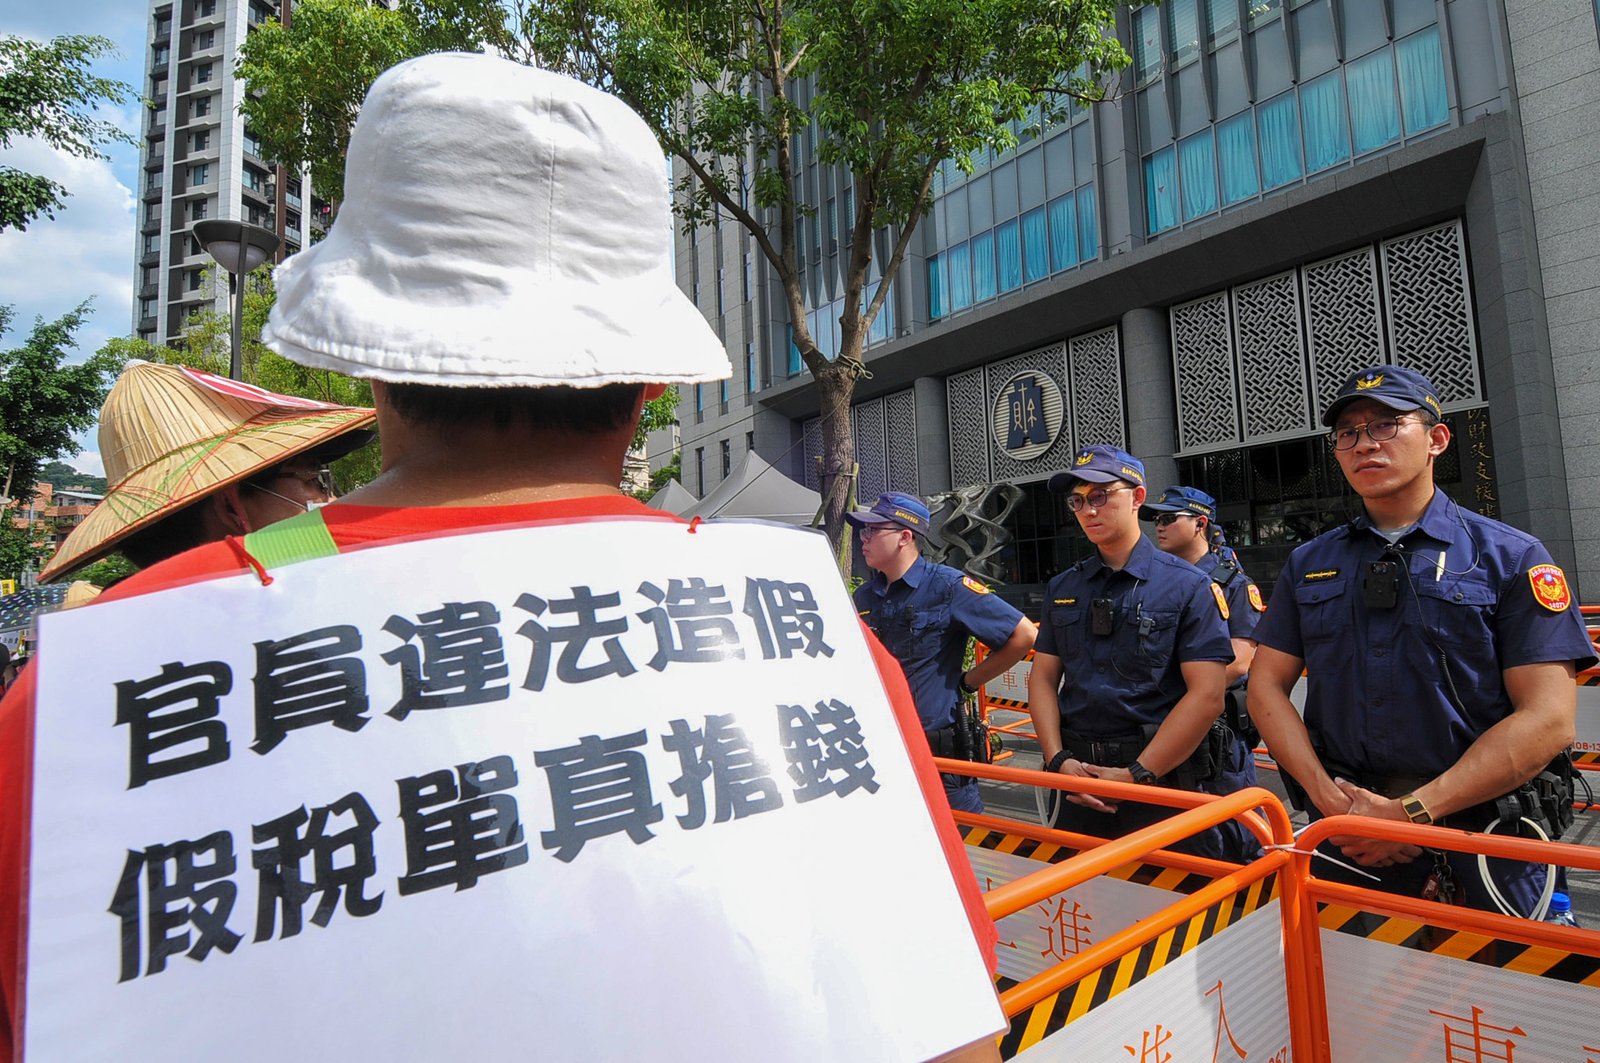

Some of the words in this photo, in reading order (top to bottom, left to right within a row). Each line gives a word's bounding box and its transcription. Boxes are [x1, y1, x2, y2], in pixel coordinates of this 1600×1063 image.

[114, 576, 836, 790] 官員違法造假
[107, 698, 880, 983] 假稅單真搶錢
